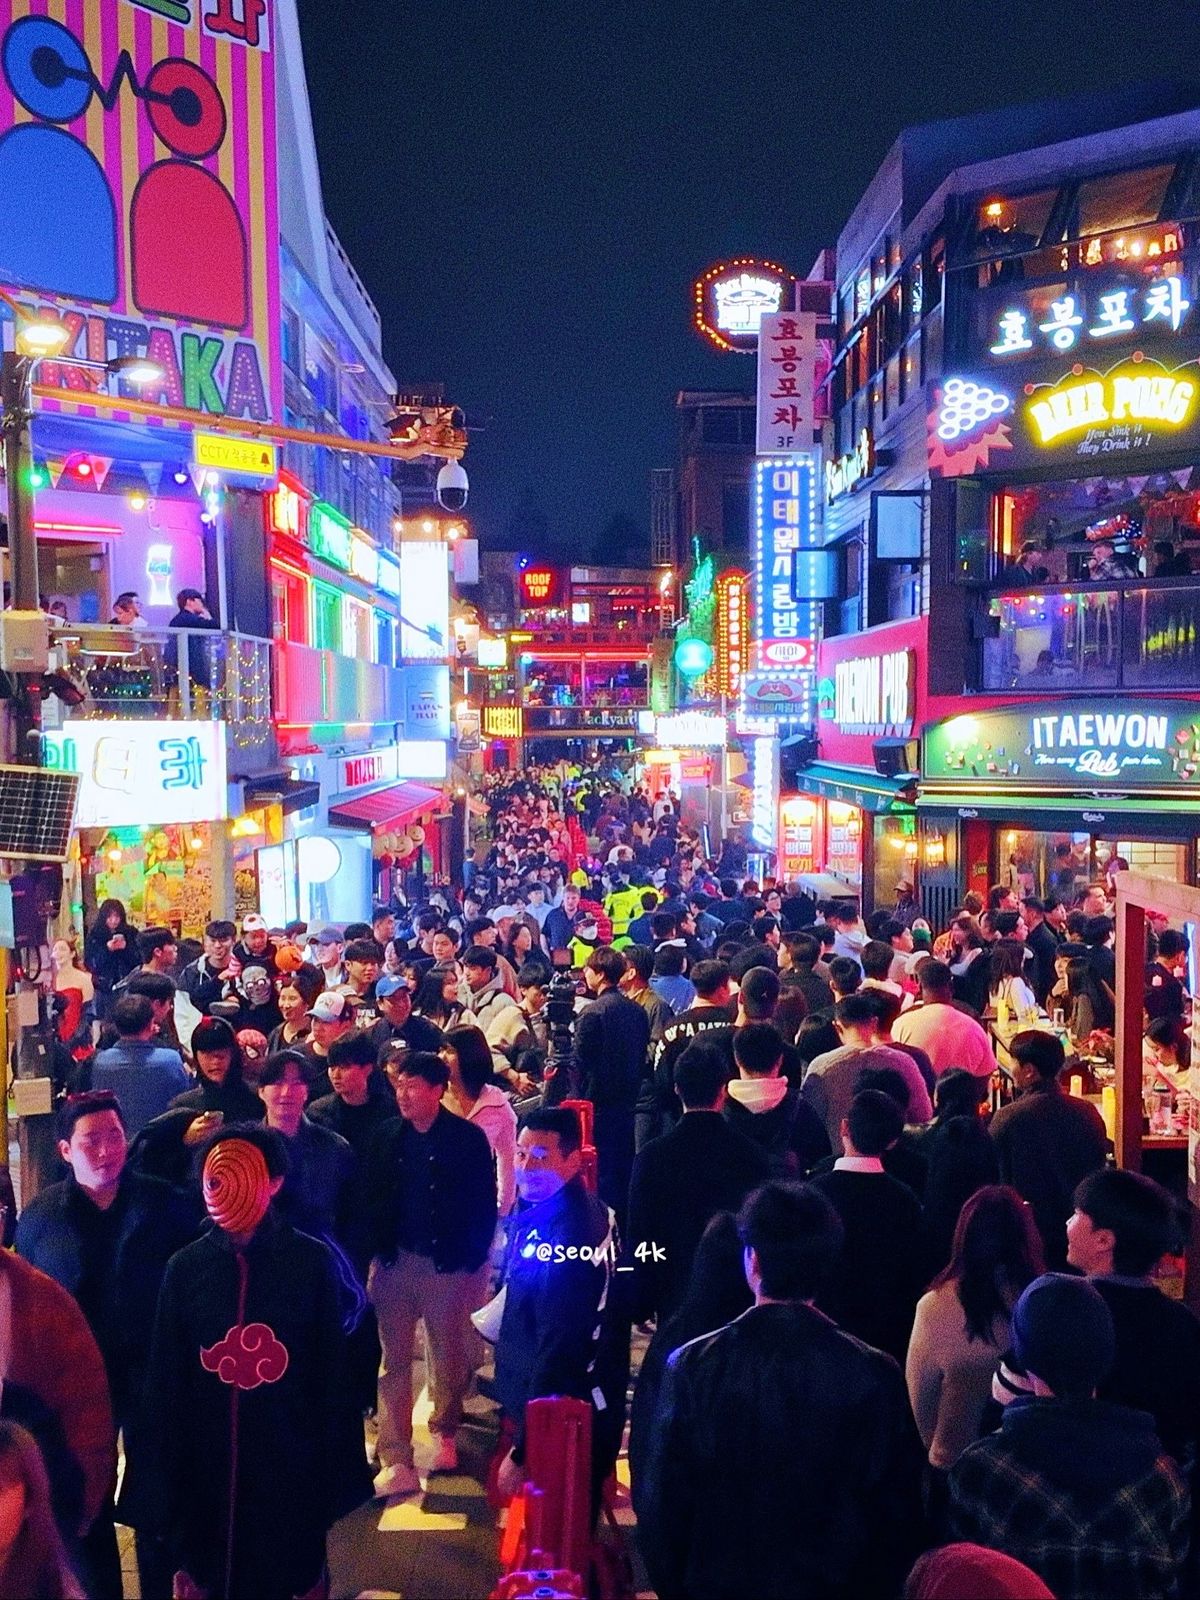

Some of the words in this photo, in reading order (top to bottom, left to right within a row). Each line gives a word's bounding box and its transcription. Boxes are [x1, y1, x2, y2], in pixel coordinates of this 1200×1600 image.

[990, 277, 1190, 355] 효봉포차
[770, 318, 803, 432] 효봉포차
[1029, 382, 1109, 443] BEER
[1111, 377, 1194, 424] PONG
[200, 443, 229, 460] CCTV
[777, 436, 795, 448] 3F
[1102, 437, 1131, 452] Drink
[525, 573, 551, 586] ROOF
[528, 585, 549, 597] TOP
[881, 650, 909, 725] PUB
[1033, 714, 1168, 749] ITAEWON
[1075, 749, 1121, 777] Pub
